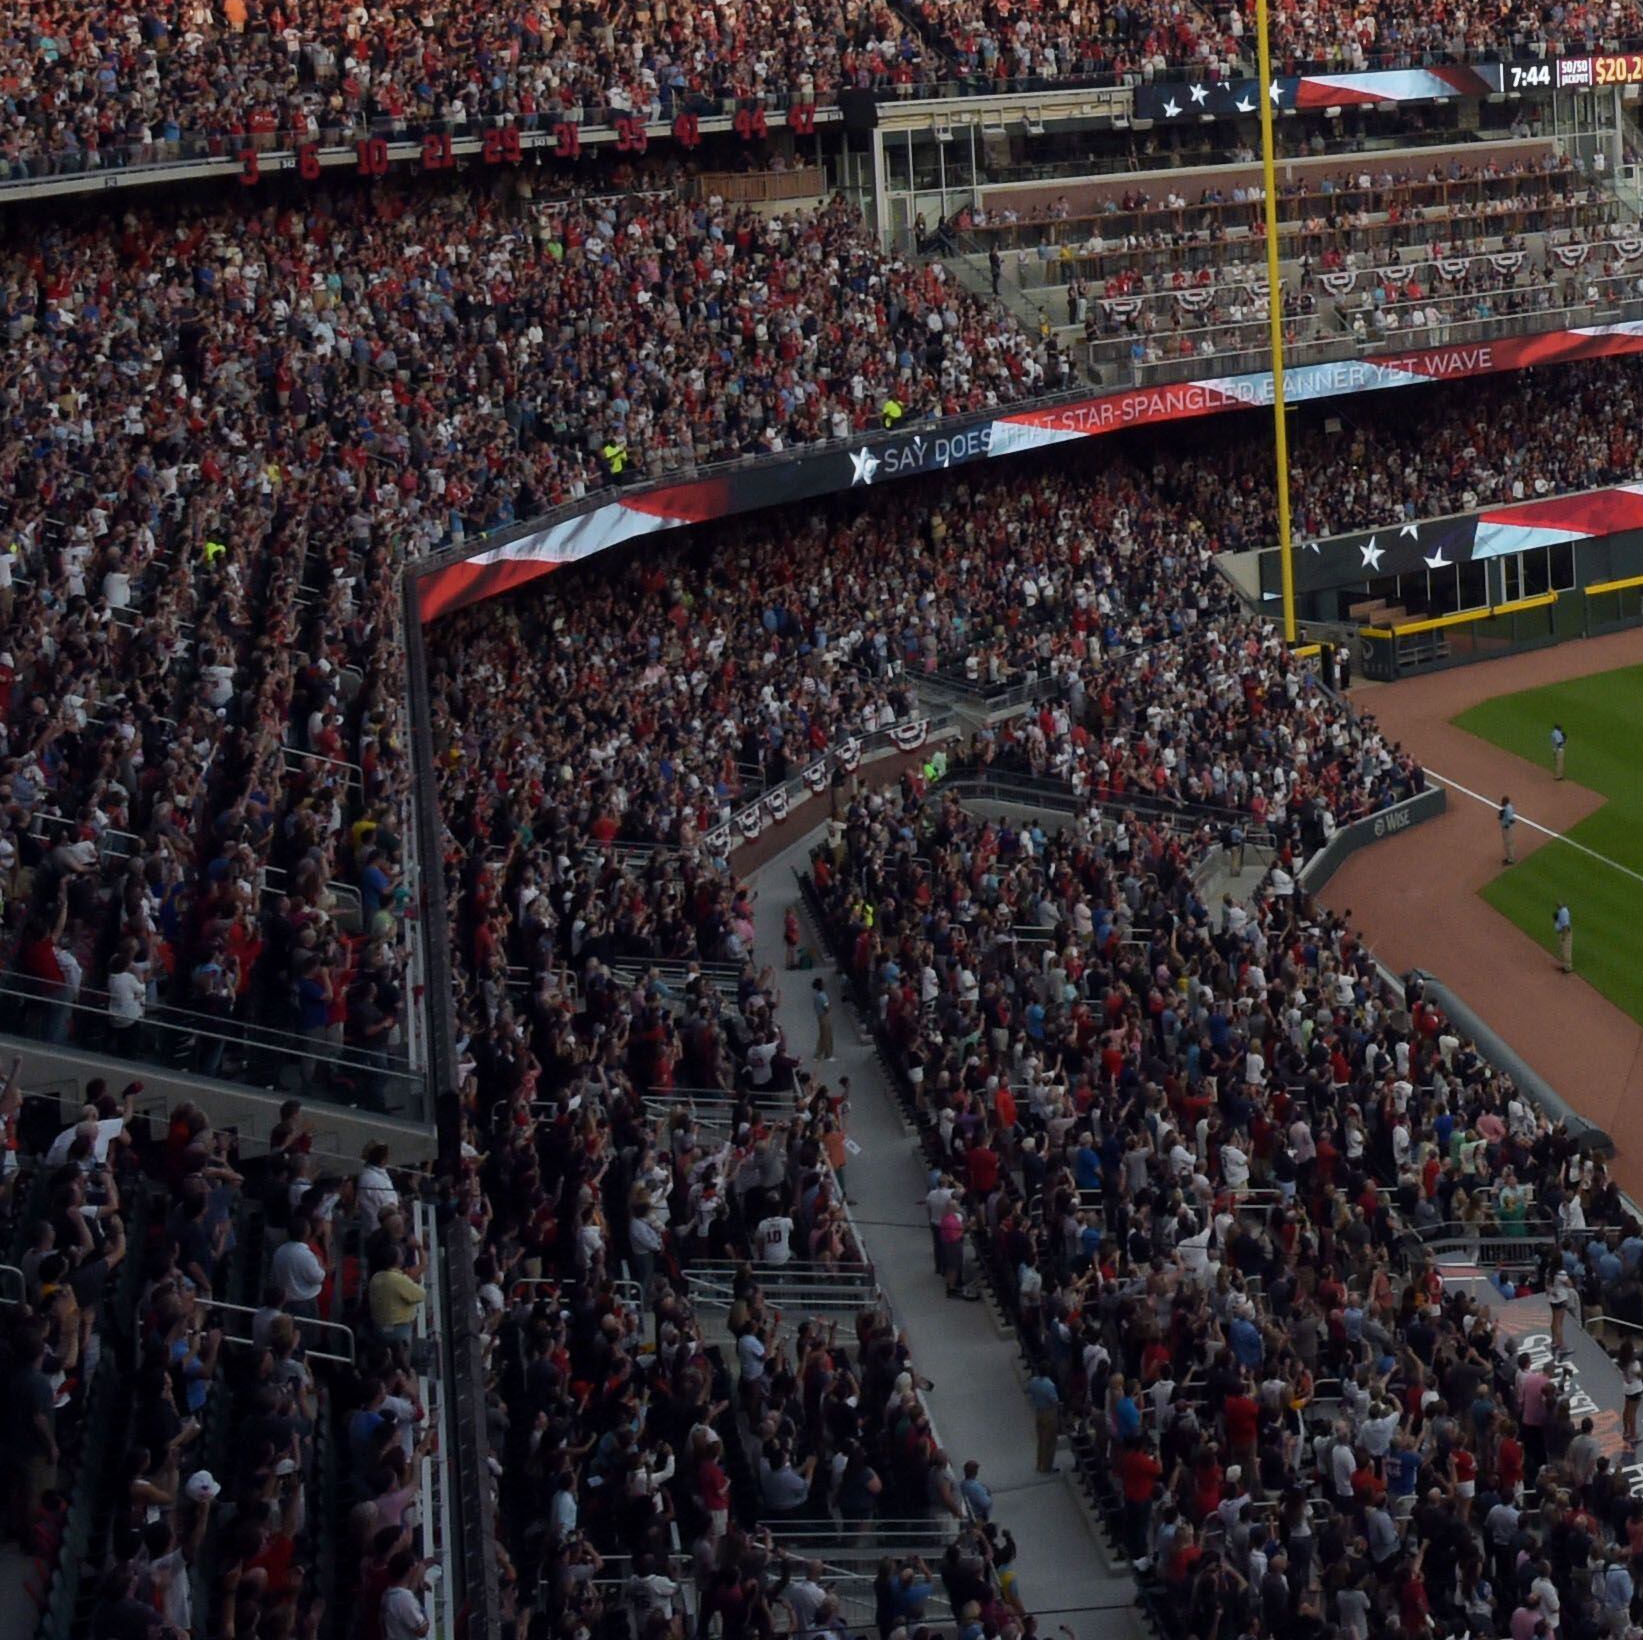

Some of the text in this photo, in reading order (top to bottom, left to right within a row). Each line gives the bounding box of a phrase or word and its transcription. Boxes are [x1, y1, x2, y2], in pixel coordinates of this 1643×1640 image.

[1511, 66, 1550, 87] 7:44
[1562, 60, 1588, 73] 50/50
[1562, 74, 1588, 86] JACKPOT
[734, 109, 766, 139] 44
[300, 143, 320, 180] 6
[356, 139, 387, 175] 10
[422, 135, 455, 169] 21
[482, 126, 521, 163] 29
[239, 148, 259, 185] 3
[884, 443, 927, 472] SAY
[935, 429, 992, 461] DOES
[1062, 382, 1254, 431] STAR-SPANGLED
[1370, 359, 1417, 381] YET
[1424, 348, 1491, 374] WAVE
